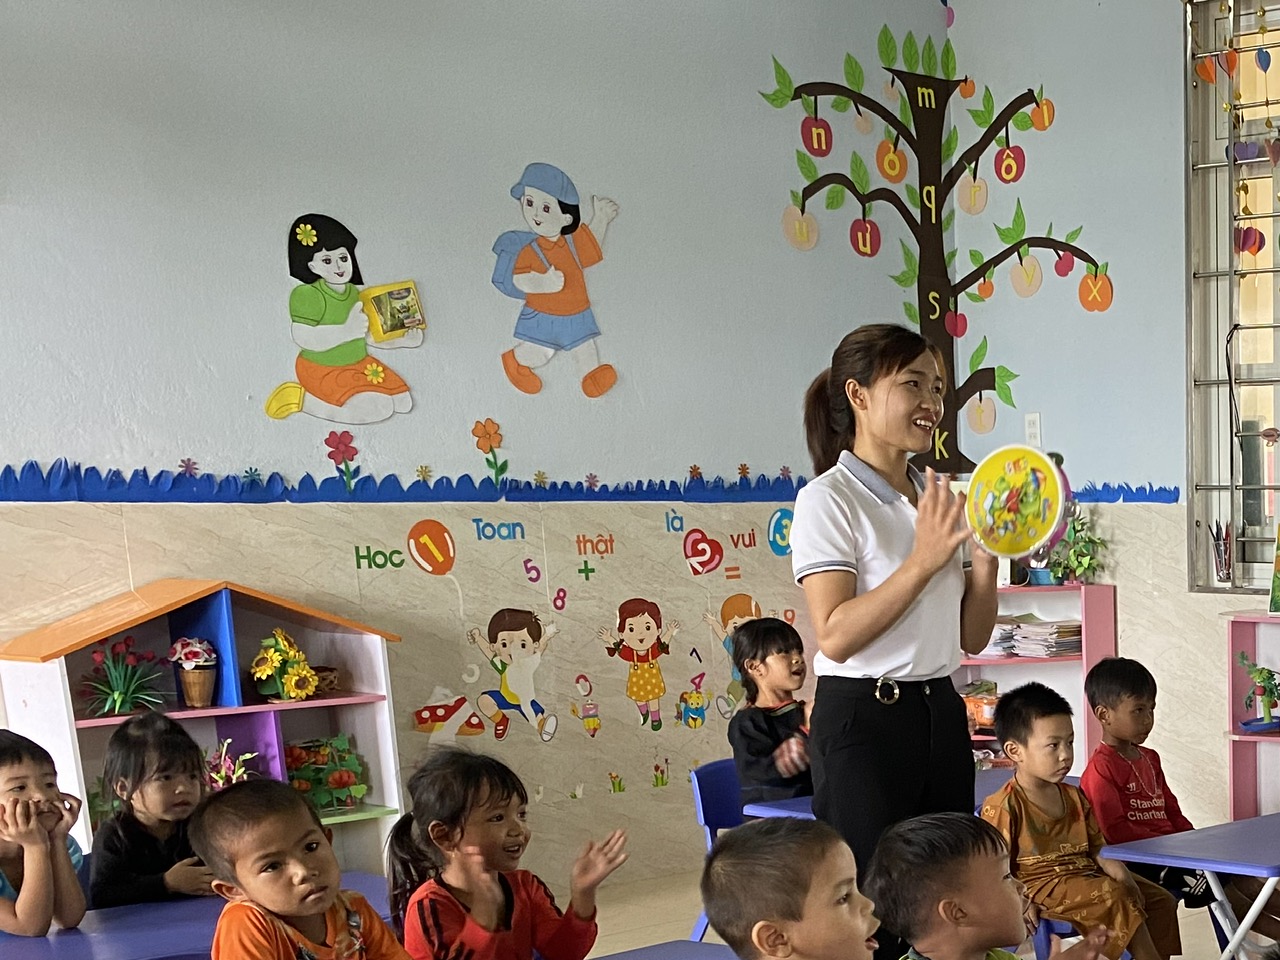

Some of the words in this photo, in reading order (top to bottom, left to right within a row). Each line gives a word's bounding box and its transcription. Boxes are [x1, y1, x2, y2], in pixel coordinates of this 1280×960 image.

[917, 86, 936, 109] m
[1042, 99, 1050, 127] i
[811, 127, 827, 150] n
[1001, 149, 1018, 181] ô
[922, 185, 936, 224] q
[969, 185, 982, 207] r
[354, 545, 405, 569] Hoc
[472, 518, 525, 541] Toan
[576, 533, 615, 560] thật
[665, 509, 684, 532] là
[729, 528, 757, 549] vui
[419, 534, 444, 563] 1
[523, 558, 541, 583] 5
[553, 588, 567, 611] 8
